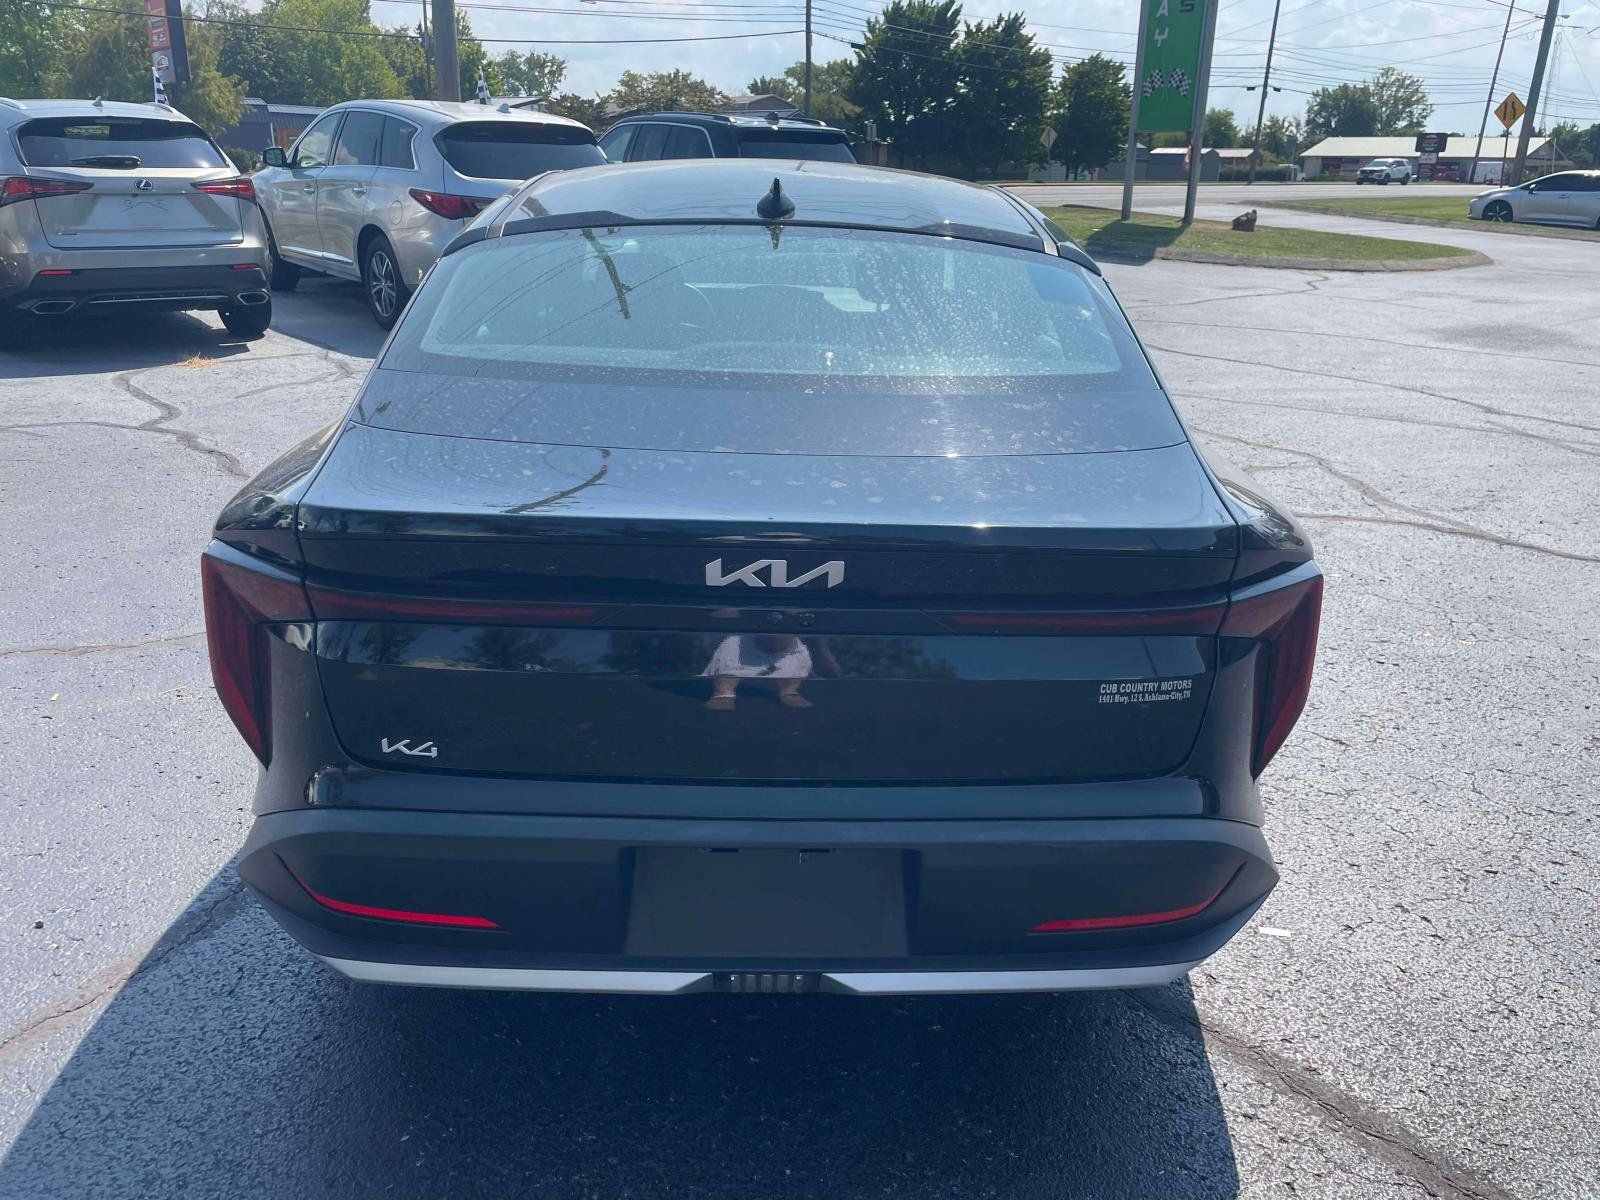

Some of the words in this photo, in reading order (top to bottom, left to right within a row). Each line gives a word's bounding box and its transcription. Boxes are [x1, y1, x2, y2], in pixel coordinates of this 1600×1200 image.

[706, 558, 845, 588] KIA
[1100, 684, 1118, 693] CUB
[1119, 682, 1159, 692] COUNTRY
[1160, 680, 1192, 691] MOTORS
[381, 737, 438, 759] K4
